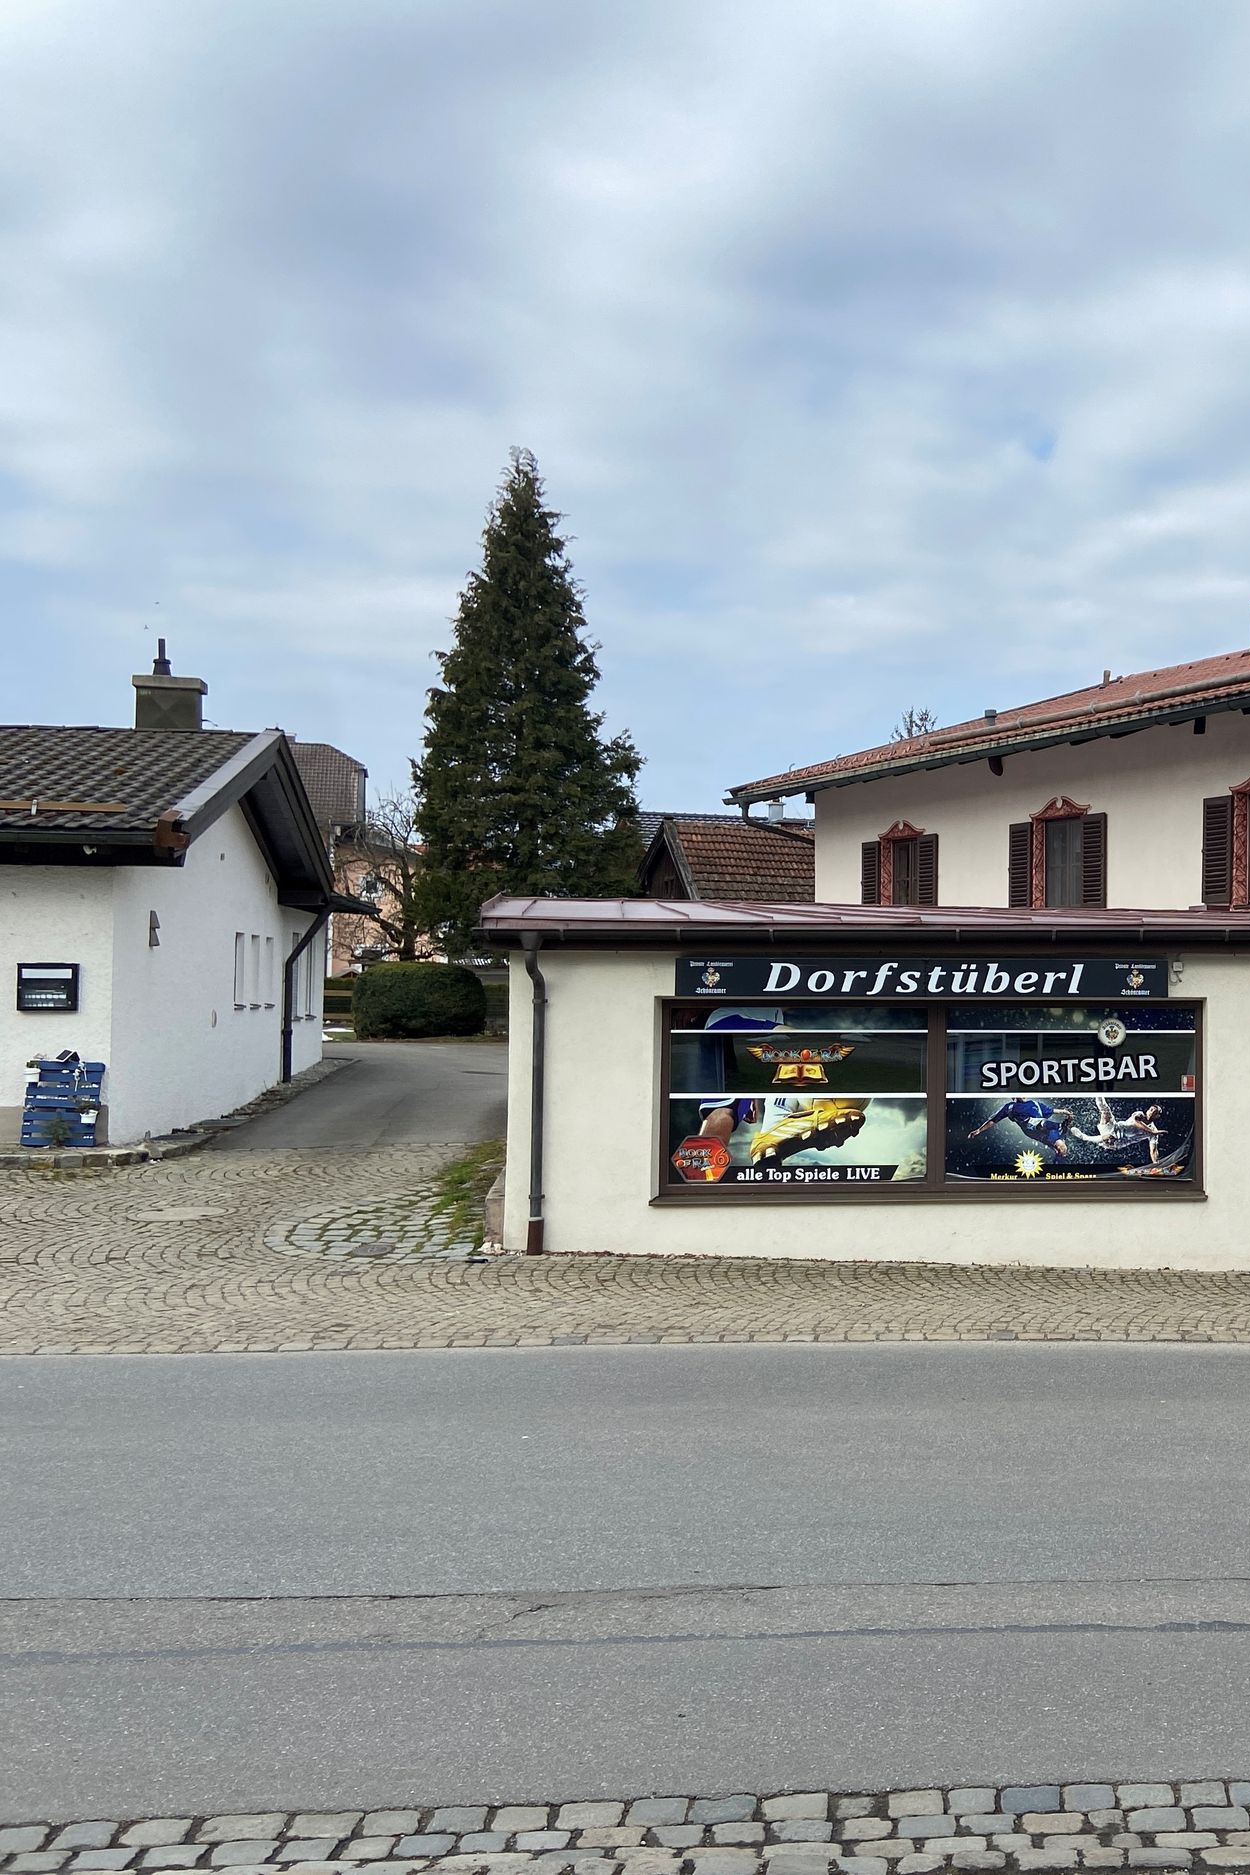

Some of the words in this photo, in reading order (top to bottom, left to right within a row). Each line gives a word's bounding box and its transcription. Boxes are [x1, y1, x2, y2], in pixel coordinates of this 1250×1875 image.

[762, 962, 1084, 995] Dorfstüberl
[981, 1055, 1158, 1087] SPORTSBAR
[737, 1168, 763, 1181] alle
[766, 1168, 792, 1182] Top
[795, 1168, 840, 1182] Spiele
[847, 1168, 880, 1180] LIVE
